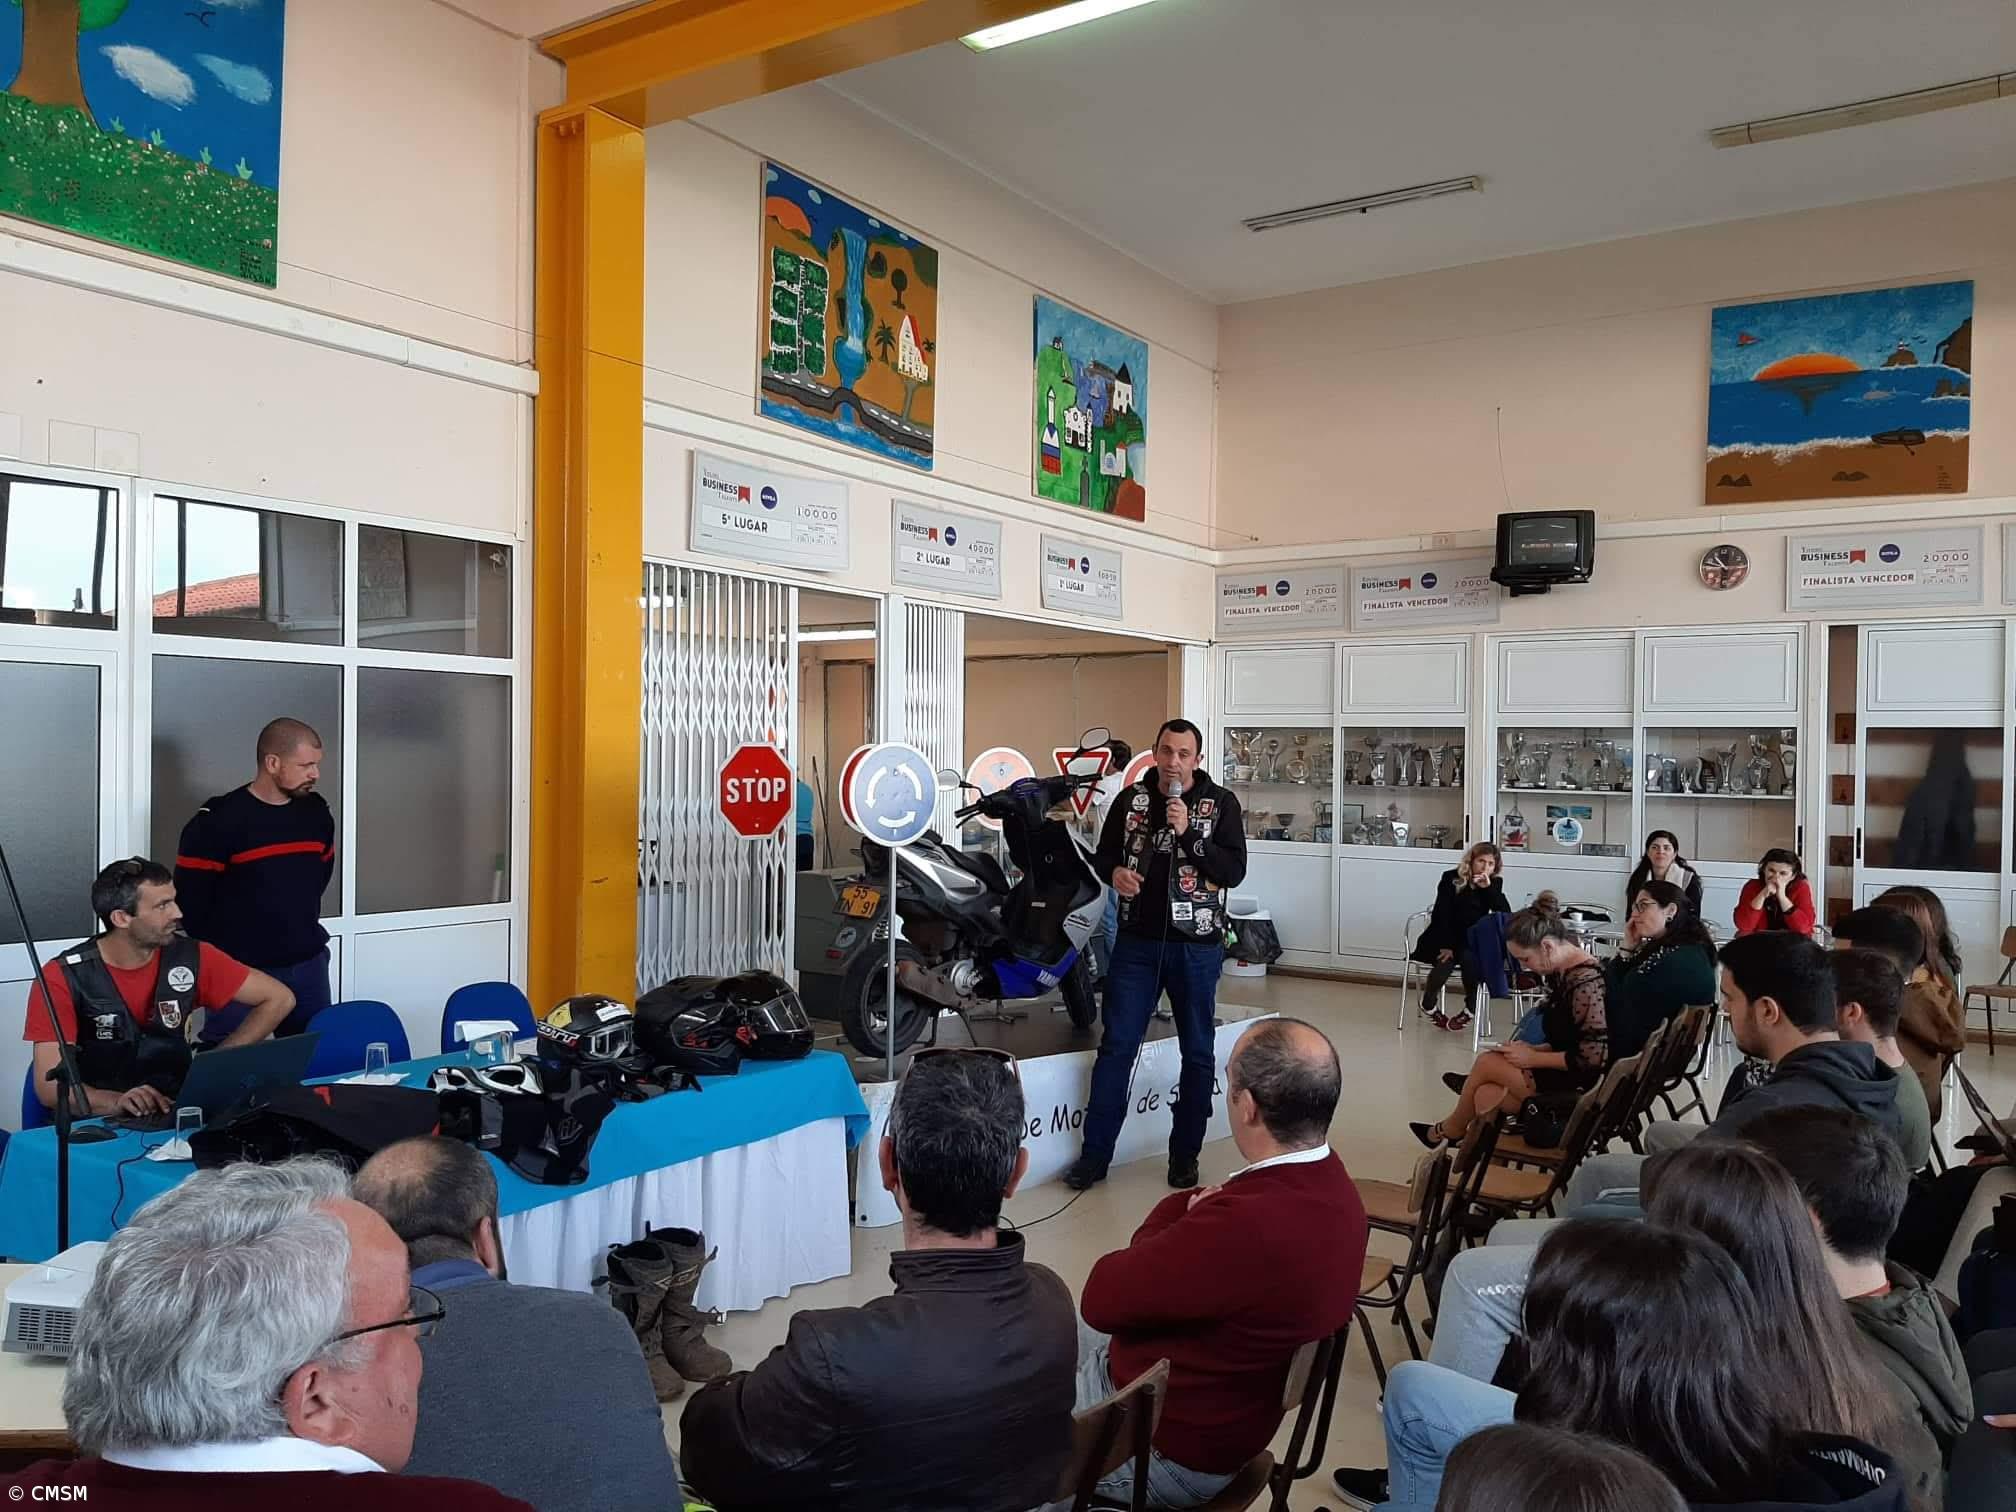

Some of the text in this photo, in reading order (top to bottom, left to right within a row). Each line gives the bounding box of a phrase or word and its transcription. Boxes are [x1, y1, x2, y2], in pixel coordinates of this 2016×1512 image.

[702, 477, 738, 495] BUSINESS
[734, 515, 768, 533] LUGAR
[900, 522, 929, 535] BUSINESS
[926, 553, 951, 567] LUGAR
[1800, 552, 1849, 561] BUSINESS
[1923, 552, 1969, 563] 20000
[1066, 580, 1085, 592] LUGAR
[1361, 581, 1398, 590] BUSINESS
[1802, 576, 1857, 586] FINALISTA
[1860, 573, 1914, 583] VENCEDOR
[1223, 587, 1256, 596] BUSINESS
[1225, 607, 1260, 616] FINALISTA
[1264, 604, 1300, 613] VENCEDOR
[1363, 601, 1404, 610] FINALISTA
[1406, 597, 1449, 607] VENCEDOR
[726, 777, 786, 804] STOP
[853, 885, 868, 899] 55
[861, 900, 876, 914] 91
[1136, 1087, 1160, 1114] de
